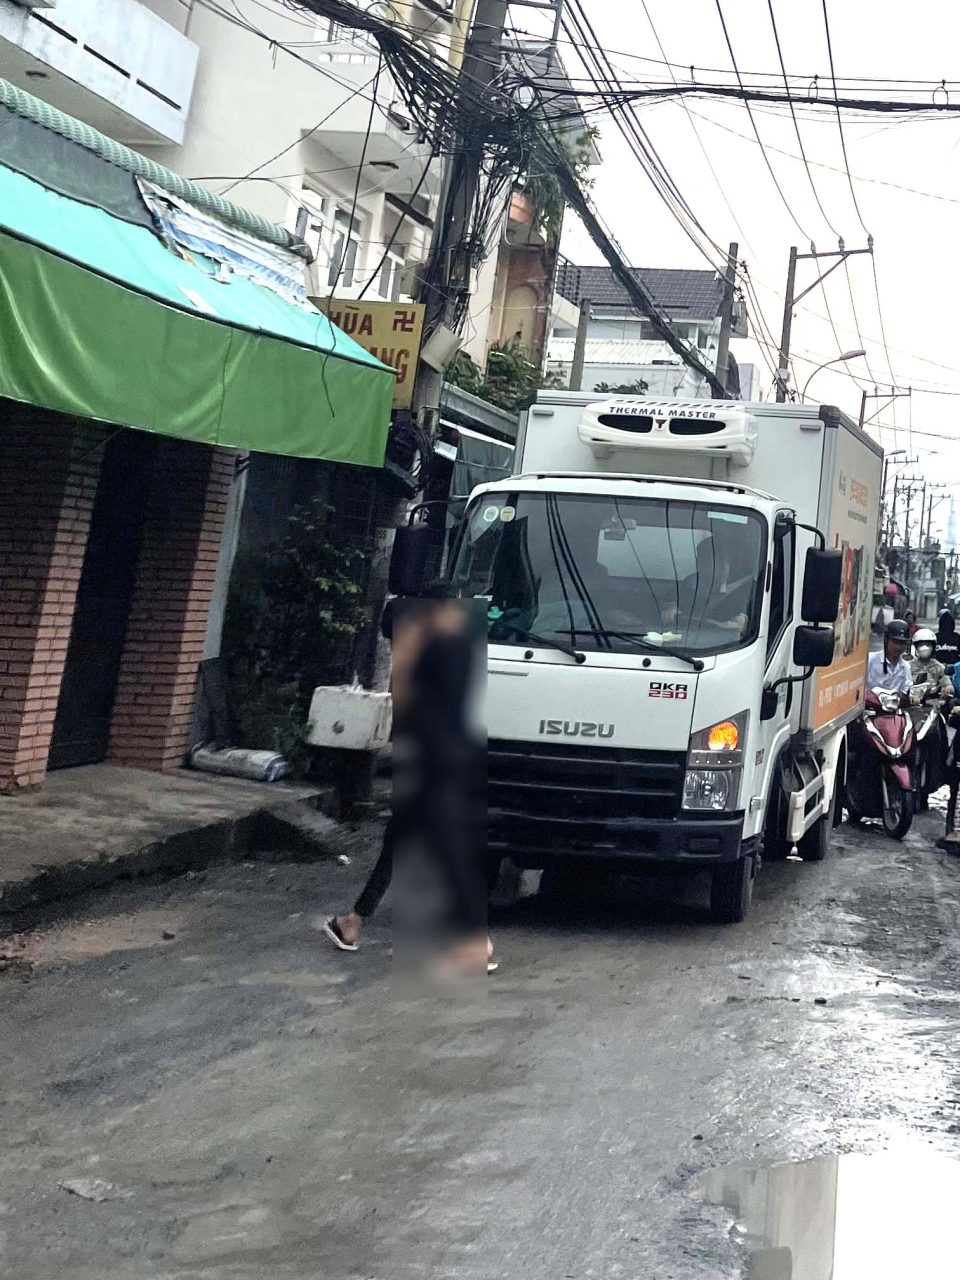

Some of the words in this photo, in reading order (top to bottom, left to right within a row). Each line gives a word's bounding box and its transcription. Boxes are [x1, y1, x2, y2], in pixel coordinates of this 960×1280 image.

[609, 406, 664, 416] THERMAL
[668, 409, 716, 419] MASTER
[649, 682, 688, 692] QKR
[649, 690, 688, 700] 230
[539, 719, 615, 738] ISUZU
